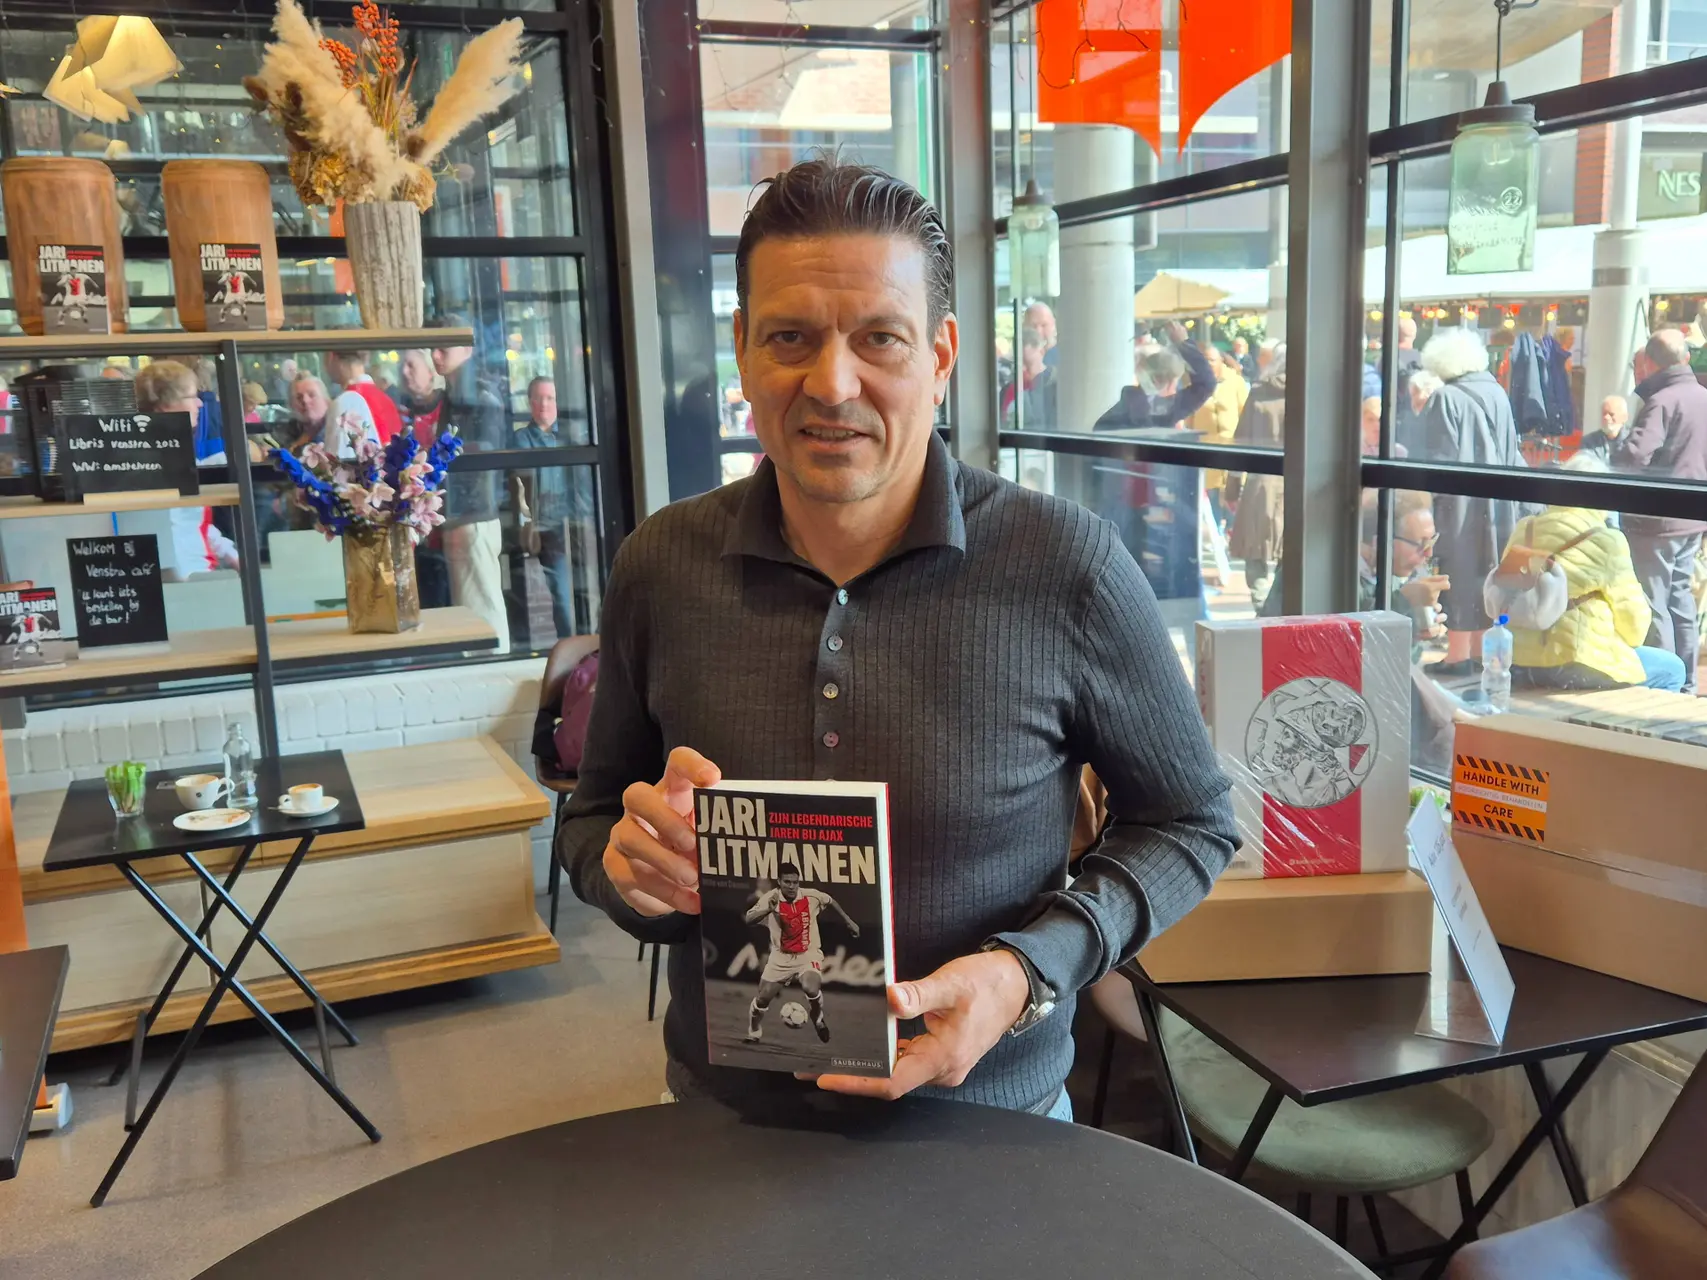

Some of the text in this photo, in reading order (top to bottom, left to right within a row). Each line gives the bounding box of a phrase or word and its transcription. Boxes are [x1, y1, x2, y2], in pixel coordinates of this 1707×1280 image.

[39, 245, 66, 259] JARI
[200, 244, 226, 258] JARI
[40, 259, 104, 273] LITMANEN
[201, 257, 262, 271] LITMANEN
[98, 418, 131, 432] Wifi
[69, 438, 104, 450] Libris
[103, 461, 162, 471] amstelveen
[85, 561, 126, 577] Venstra
[0, 591, 19, 604] ARI
[0, 599, 57, 616] ITMANEN
[1463, 770, 1539, 795] HANDLE WITH
[697, 794, 873, 837] JARI ZIJN LEGENDARISCHE
[1483, 804, 1513, 818] CARE
[770, 828, 844, 842] JAREN BIJ AJAX
[700, 836, 876, 885] LITMANEN
[832, 1059, 881, 1068] SAUBERHAUS
